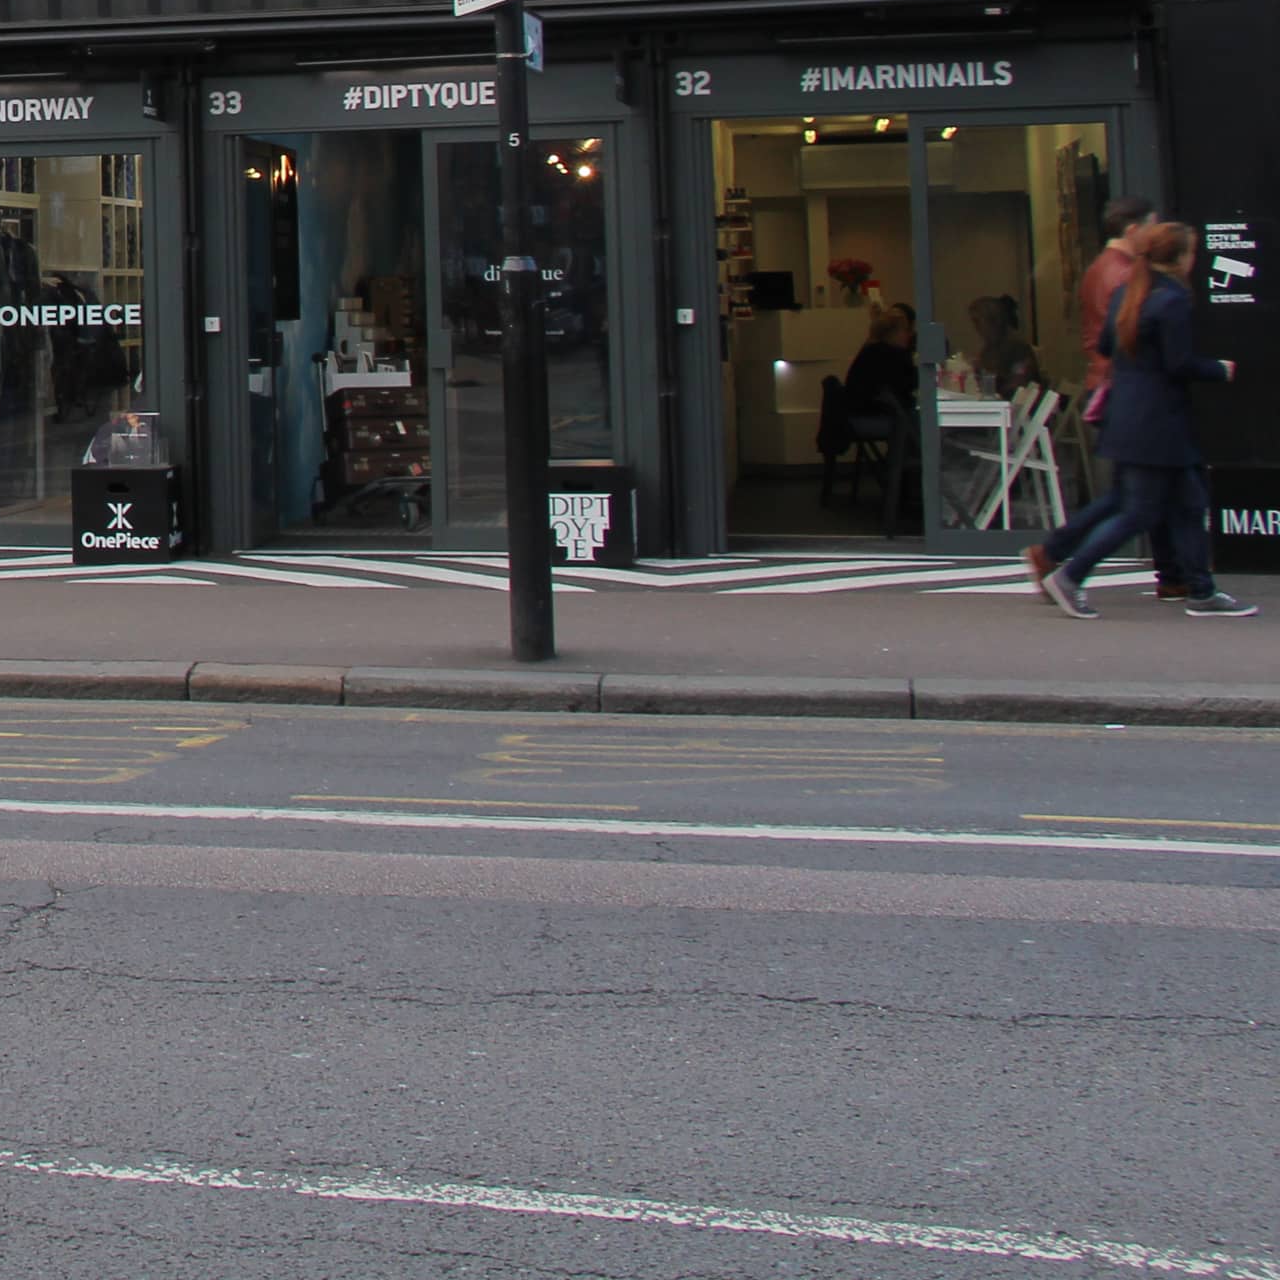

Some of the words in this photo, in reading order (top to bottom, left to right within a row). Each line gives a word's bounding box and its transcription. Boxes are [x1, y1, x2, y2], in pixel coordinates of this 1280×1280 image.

[675, 71, 711, 96] 32
[801, 61, 1013, 92] #IMARNINAILS
[209, 91, 242, 114] 33
[343, 81, 496, 109] #DIPTYQUE
[509, 133, 520, 147] 5
[548, 496, 609, 517] DIPT
[81, 532, 160, 549] OnePiece
